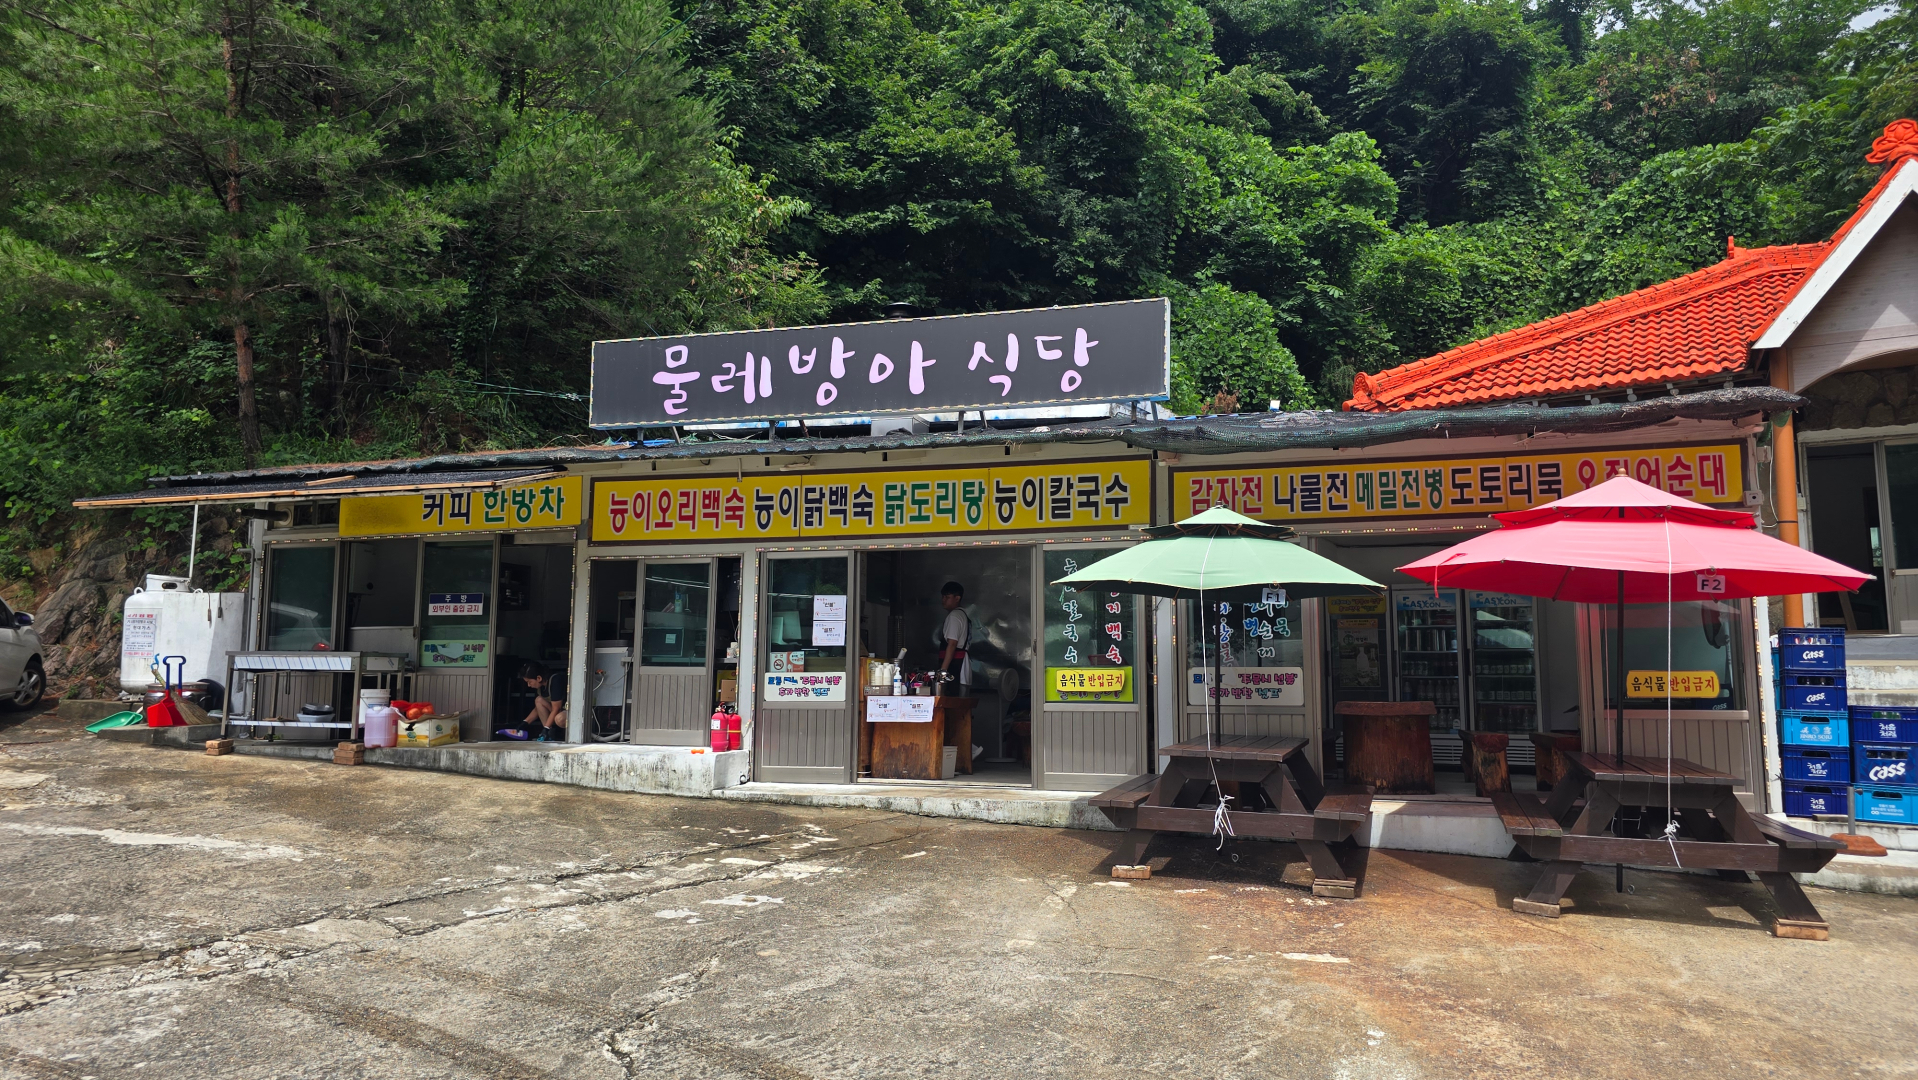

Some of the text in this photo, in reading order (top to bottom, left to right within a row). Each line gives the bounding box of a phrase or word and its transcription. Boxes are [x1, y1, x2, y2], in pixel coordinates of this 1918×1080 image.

[652, 327, 1100, 416] 물레방아 식당
[1190, 476, 1263, 516] 감자전
[1273, 472, 1349, 513] 나물전
[1355, 468, 1443, 511] 메밀전병
[1450, 462, 1562, 505] 도토리묵
[421, 485, 565, 526] 커피 한방차
[608, 473, 1131, 534] 능이오리백숙 능이닭백숙 닭도리탕 능이칼국수
[1701, 579, 1722, 591] F2
[1266, 592, 1281, 603] F1
[432, 605, 451, 613] 외부인
[467, 604, 480, 613] 금지
[1059, 673, 1123, 688] 음식물 반입금지
[1631, 676, 1715, 692] 음식물 반입금지
